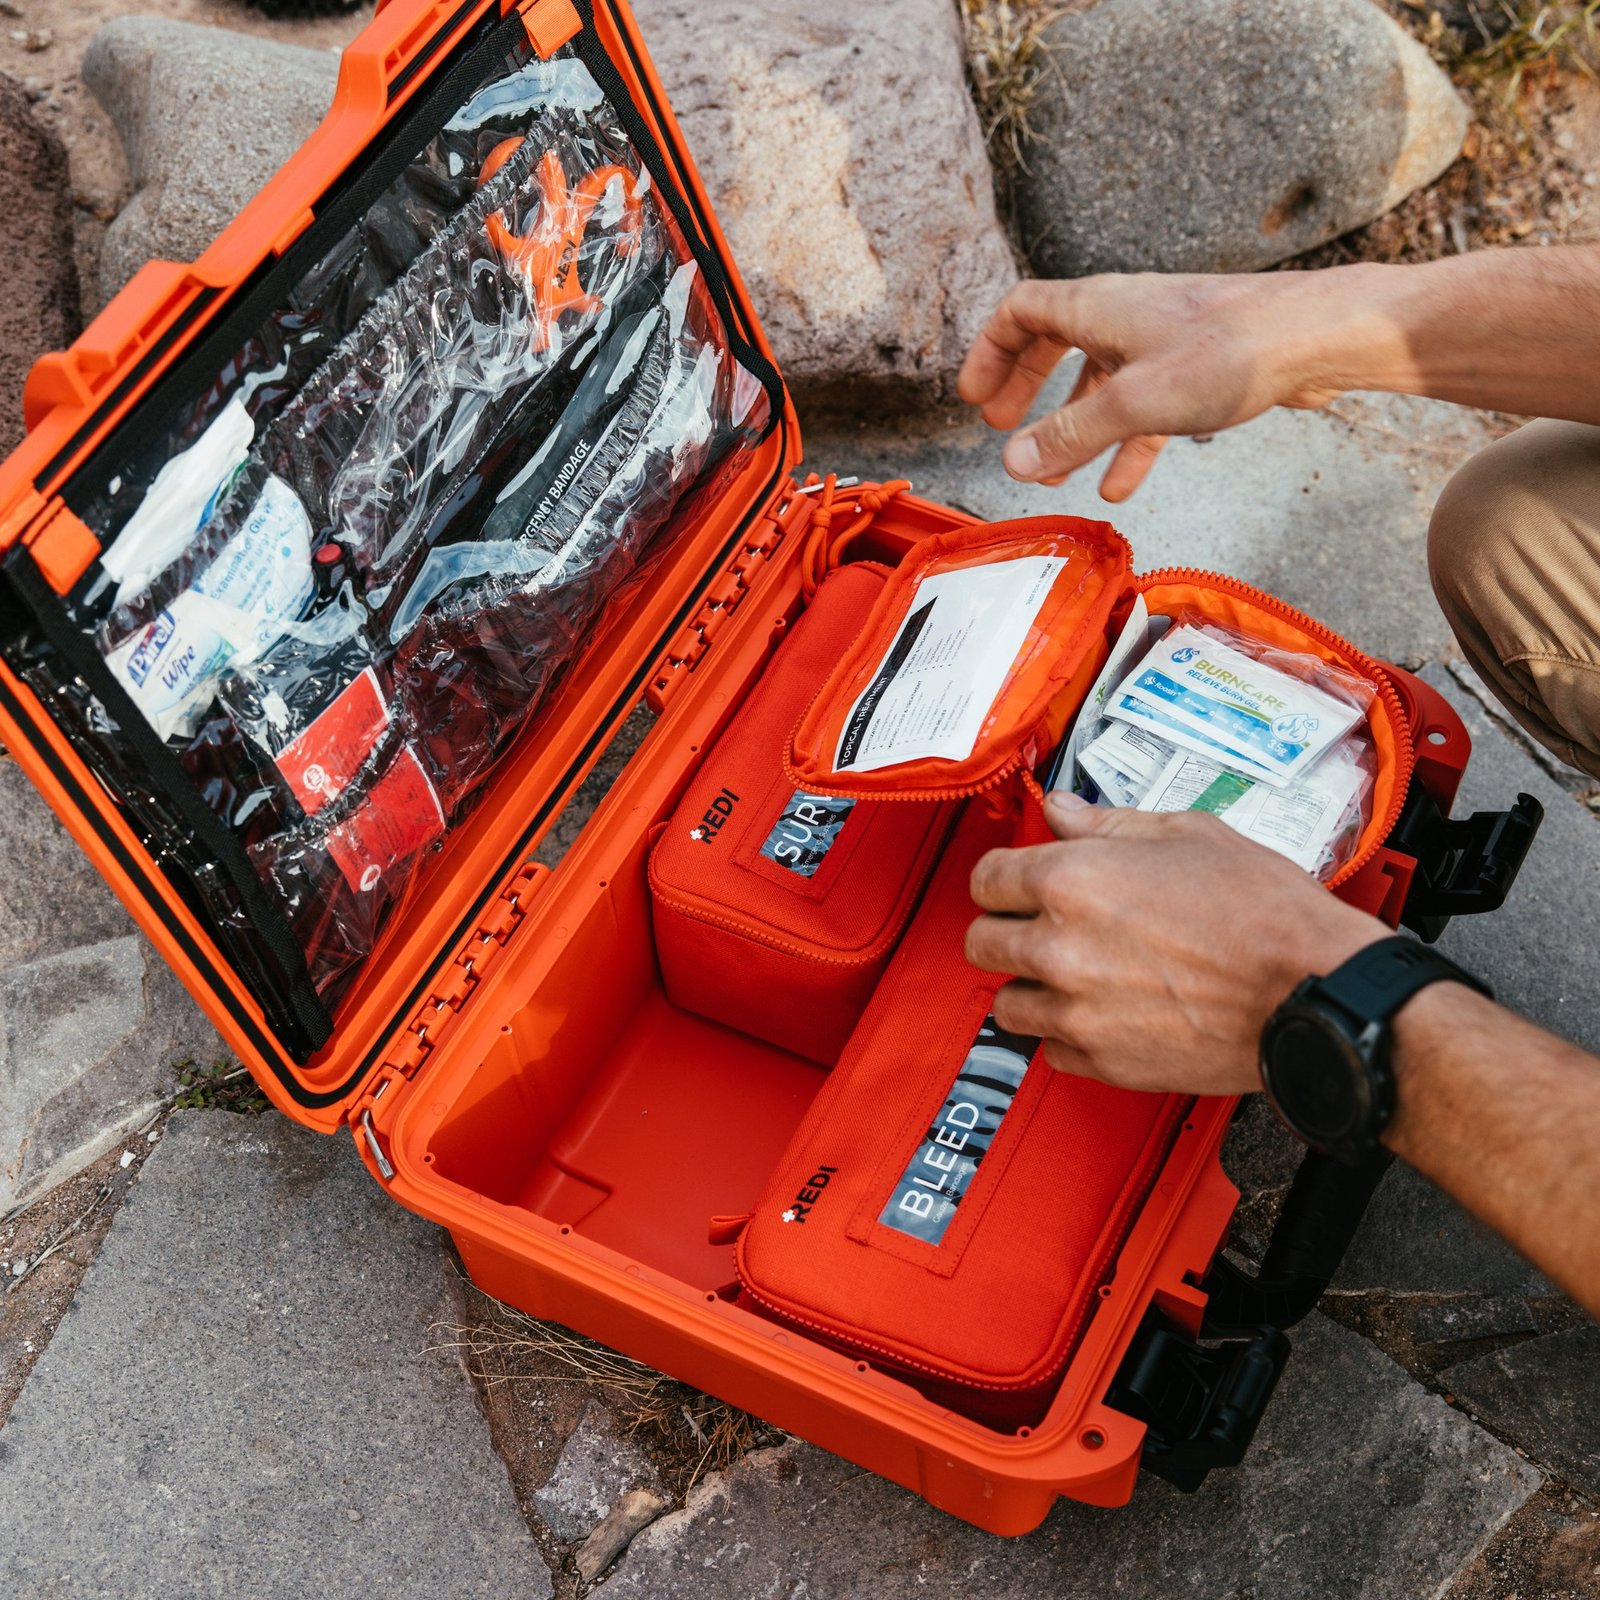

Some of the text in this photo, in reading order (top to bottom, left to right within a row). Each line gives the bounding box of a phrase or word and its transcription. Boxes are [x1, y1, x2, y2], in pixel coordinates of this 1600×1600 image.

[555, 240, 576, 289] REDI
[513, 439, 591, 552] ERGENCY BANDAGE
[162, 646, 195, 689] Wipe
[1186, 669, 1261, 711] RELIEVE BURN GEL
[1194, 659, 1288, 712] BURNCARE
[841, 722, 862, 764] TOPICAL
[857, 677, 887, 723] TREATMENT
[1267, 738, 1288, 756] 3.5g
[700, 788, 740, 844] REDI
[818, 814, 836, 841] Supplies
[899, 1102, 980, 1218] BLEED
[791, 1166, 838, 1223] REDI
[932, 1162, 969, 1224] Gauze Bandages
